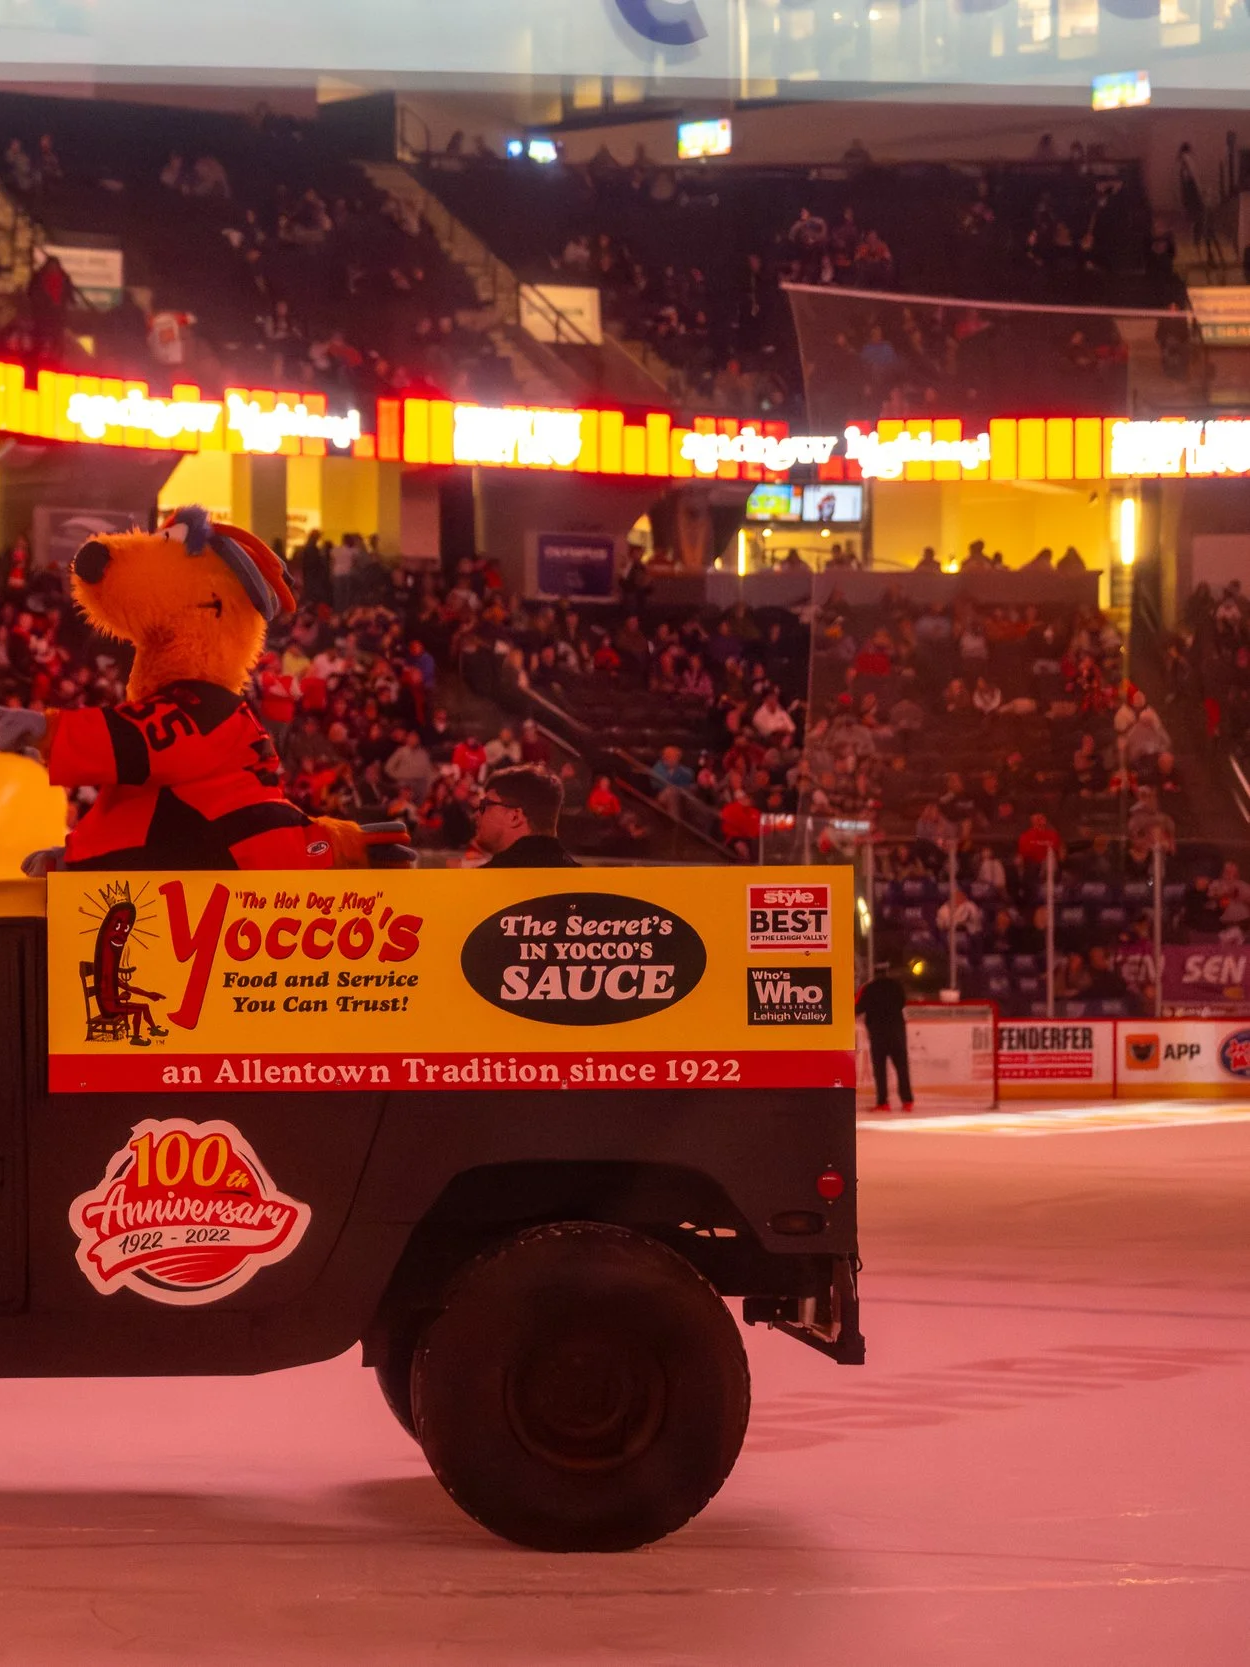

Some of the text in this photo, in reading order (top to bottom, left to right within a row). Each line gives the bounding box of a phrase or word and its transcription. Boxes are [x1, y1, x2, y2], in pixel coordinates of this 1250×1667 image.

[274, 891, 301, 909] Hot
[306, 891, 336, 915] Dog
[763, 889, 815, 907] style
[500, 915, 674, 937] The Secret's
[750, 909, 828, 933] BEST
[750, 934, 761, 942] OF
[762, 934, 775, 942] THE
[802, 934, 828, 942] VALLEY
[519, 941, 654, 961] IN YOCCO'S
[223, 970, 419, 989] Food and Service
[500, 965, 676, 1001] SAUCE
[752, 970, 790, 980] Who's
[754, 981, 823, 1004] Who
[233, 995, 409, 1013] You Can Trust!
[753, 1011, 827, 1022] Lehigh Valley
[972, 1026, 1093, 1051] DIFENDERFER
[1163, 1043, 1201, 1061] APP
[162, 1057, 741, 1085] an Allentown Tradition since 1922
[86, 1184, 291, 1236] Anniversary
[118, 1231, 163, 1255] 1922
[184, 1228, 231, 1245] 2022
